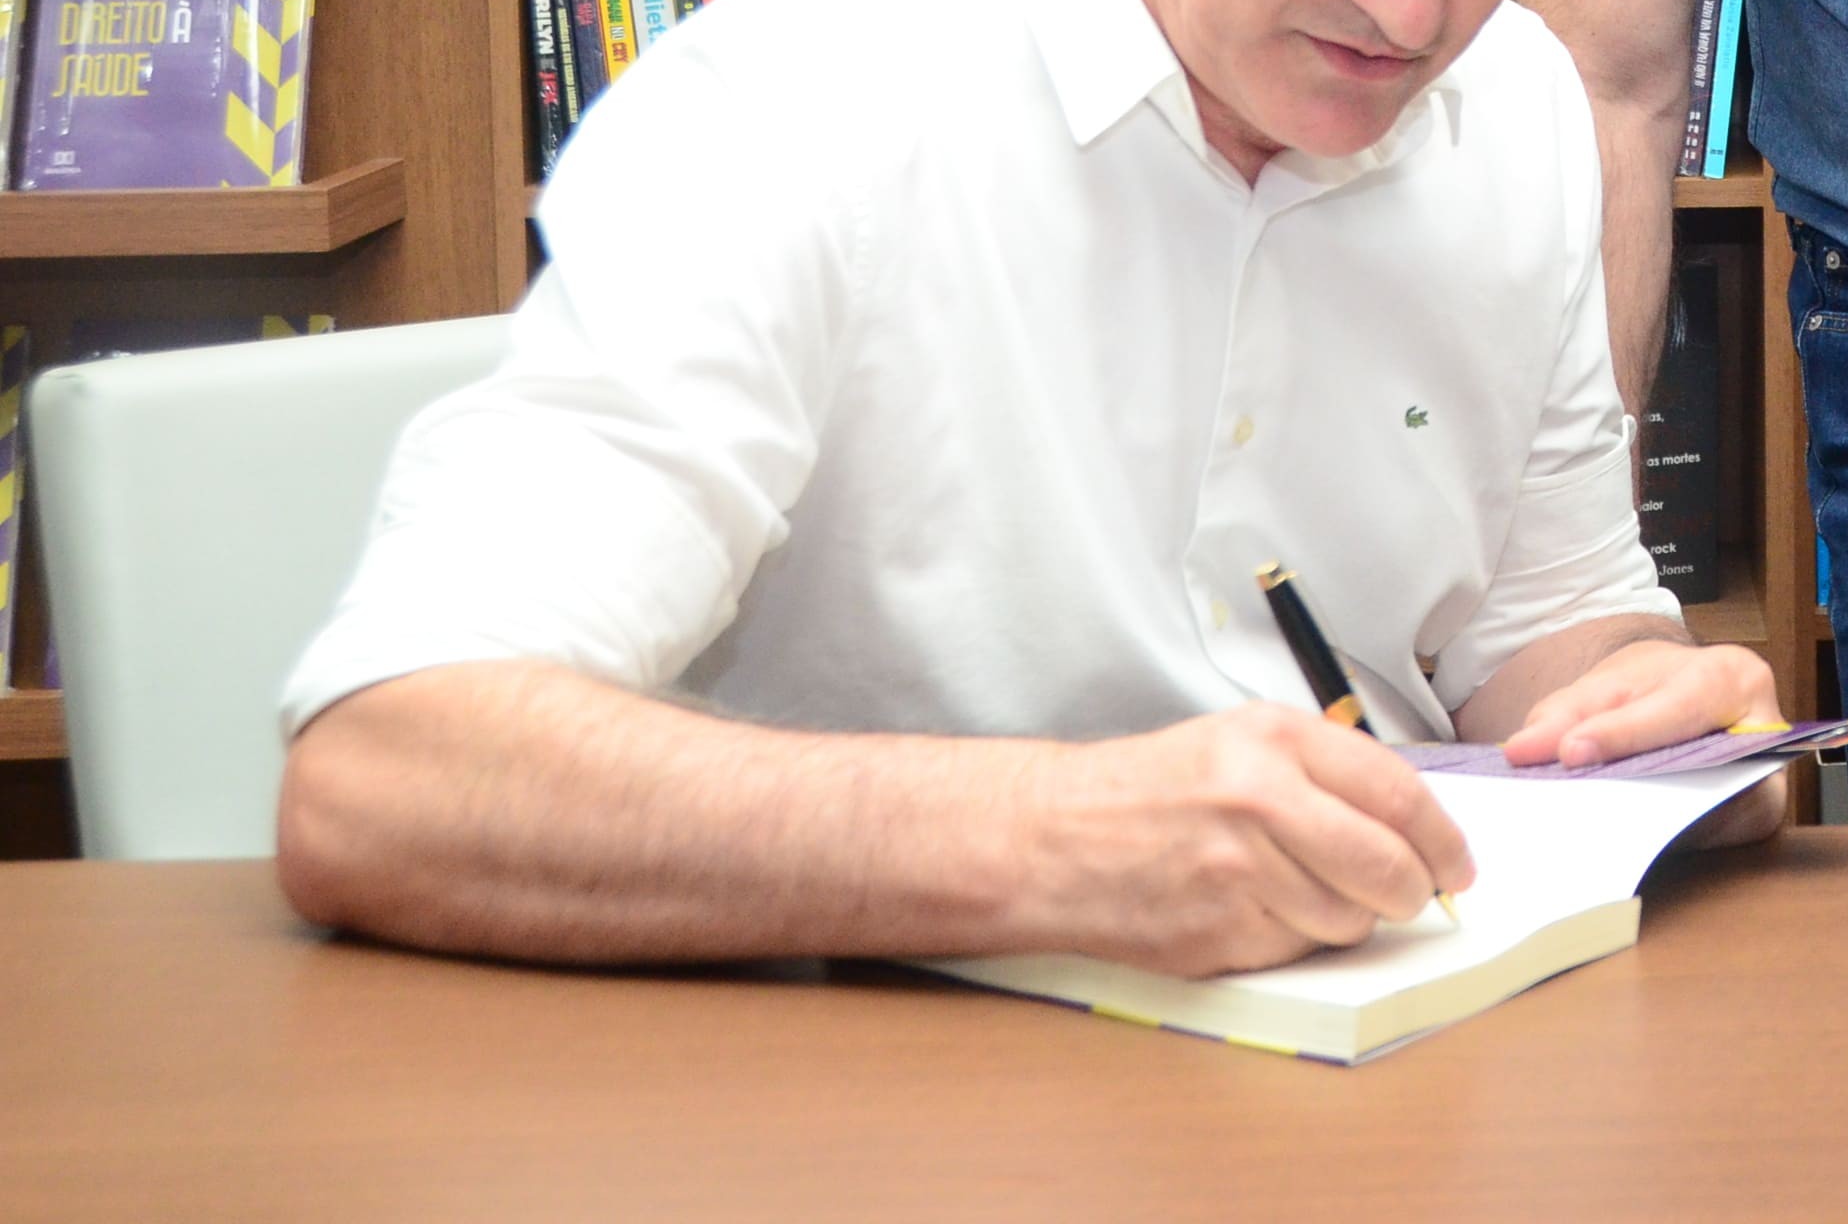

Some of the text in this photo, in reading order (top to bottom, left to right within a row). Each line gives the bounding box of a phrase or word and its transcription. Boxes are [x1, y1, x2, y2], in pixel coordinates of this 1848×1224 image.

[59, 0, 192, 46] DIREITO À
[610, 25, 623, 40] NO
[611, 42, 628, 64] CRY
[52, 52, 150, 97] SAÚDE
[1646, 452, 1702, 467] as mortes
[1650, 542, 1677, 555] rock
[1658, 564, 1694, 577] Jones
